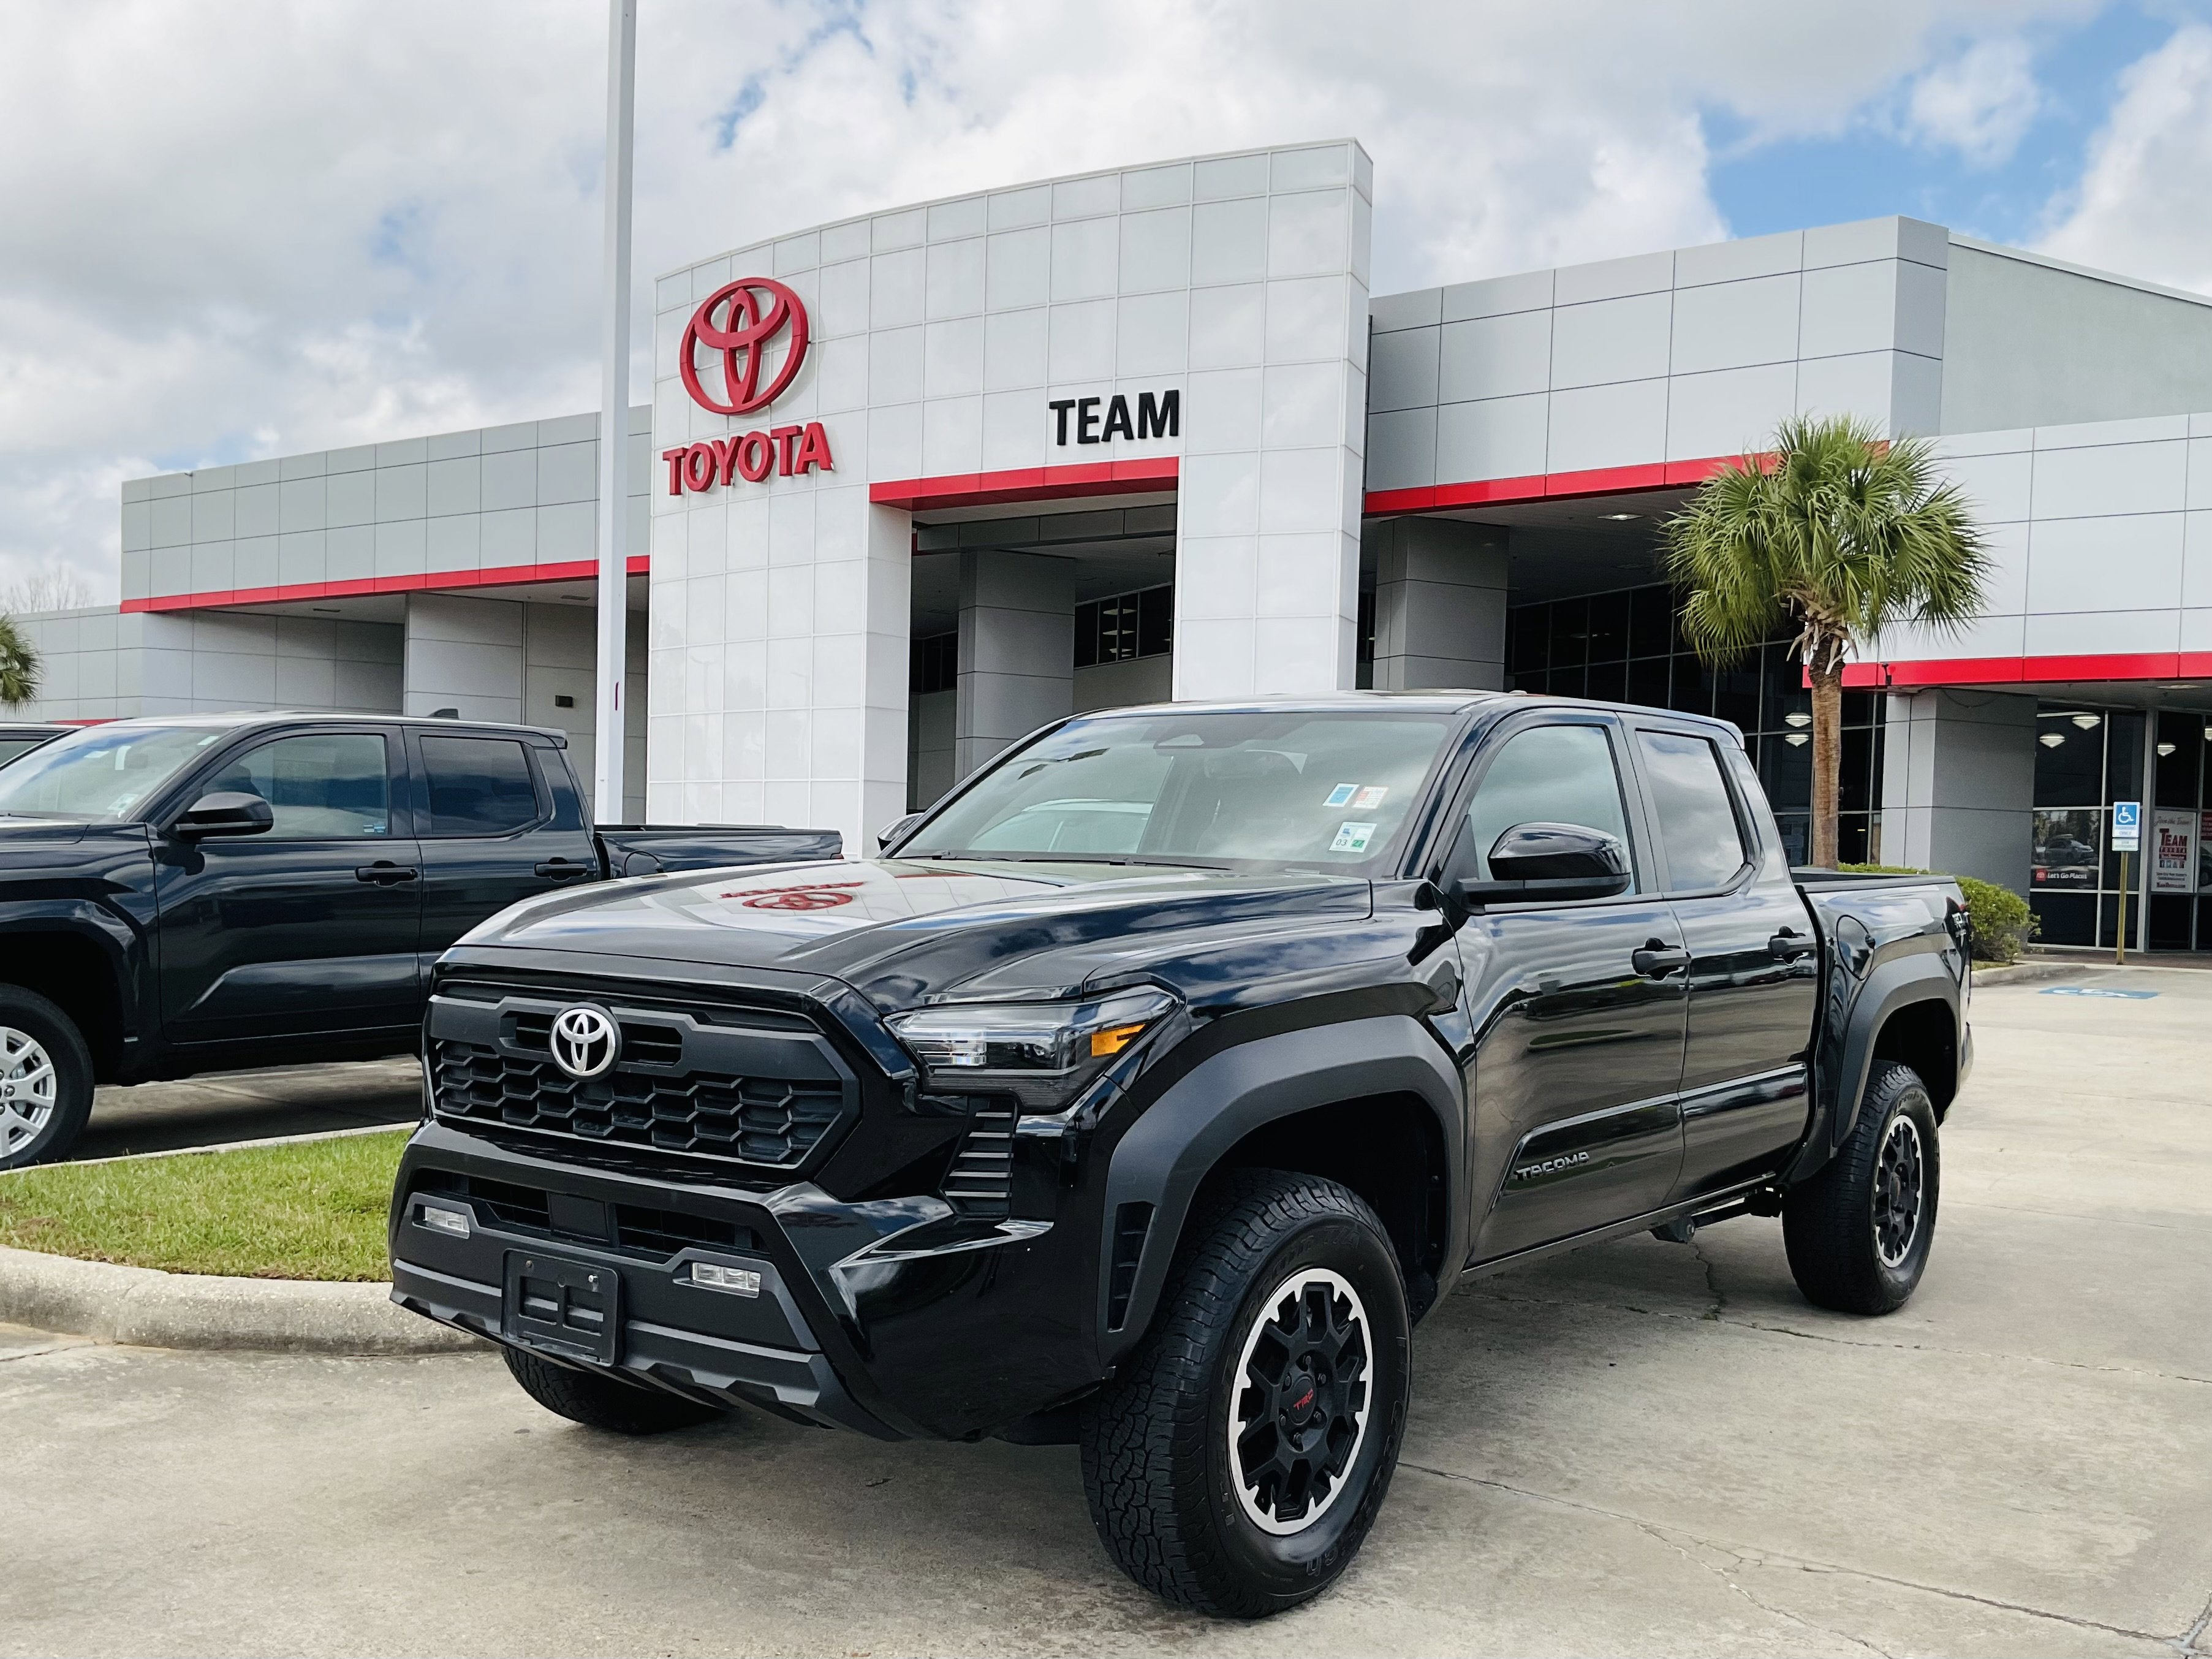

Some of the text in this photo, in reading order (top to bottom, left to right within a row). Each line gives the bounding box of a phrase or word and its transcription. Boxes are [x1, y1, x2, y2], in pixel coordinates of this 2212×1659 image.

[1048, 389, 1179, 446] TEAM
[662, 421, 834, 495] TOYOTA
[1352, 840, 1365, 848] 27
[1516, 1152, 1590, 1180] TACOMA
[1293, 1388, 1314, 1410] TRD
